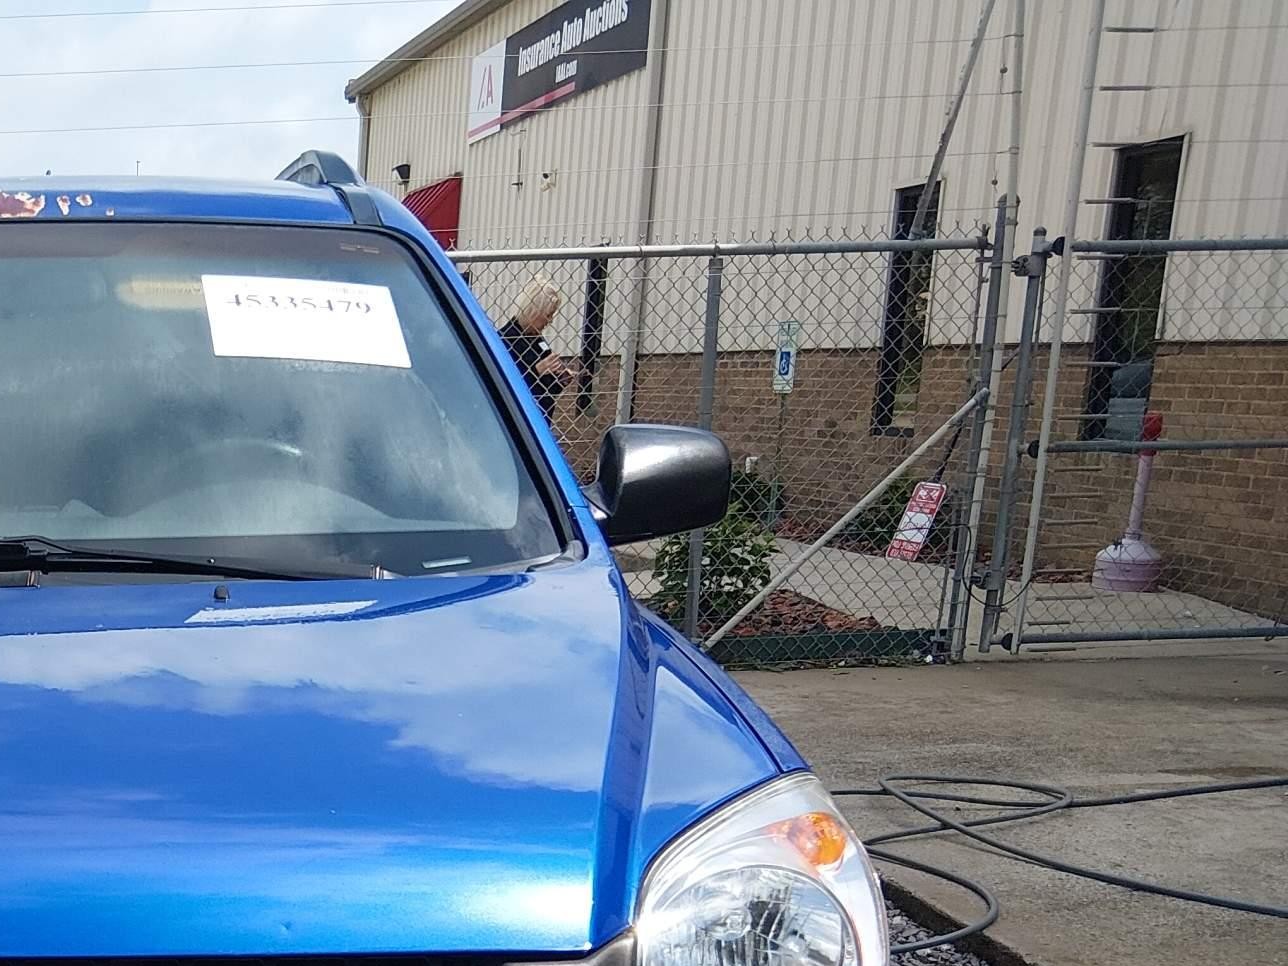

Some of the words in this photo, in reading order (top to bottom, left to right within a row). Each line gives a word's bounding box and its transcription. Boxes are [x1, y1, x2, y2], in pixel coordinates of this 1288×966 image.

[517, 30, 560, 77] Insurance
[560, 16, 583, 54] Auto
[583, 0, 628, 42] Auctions
